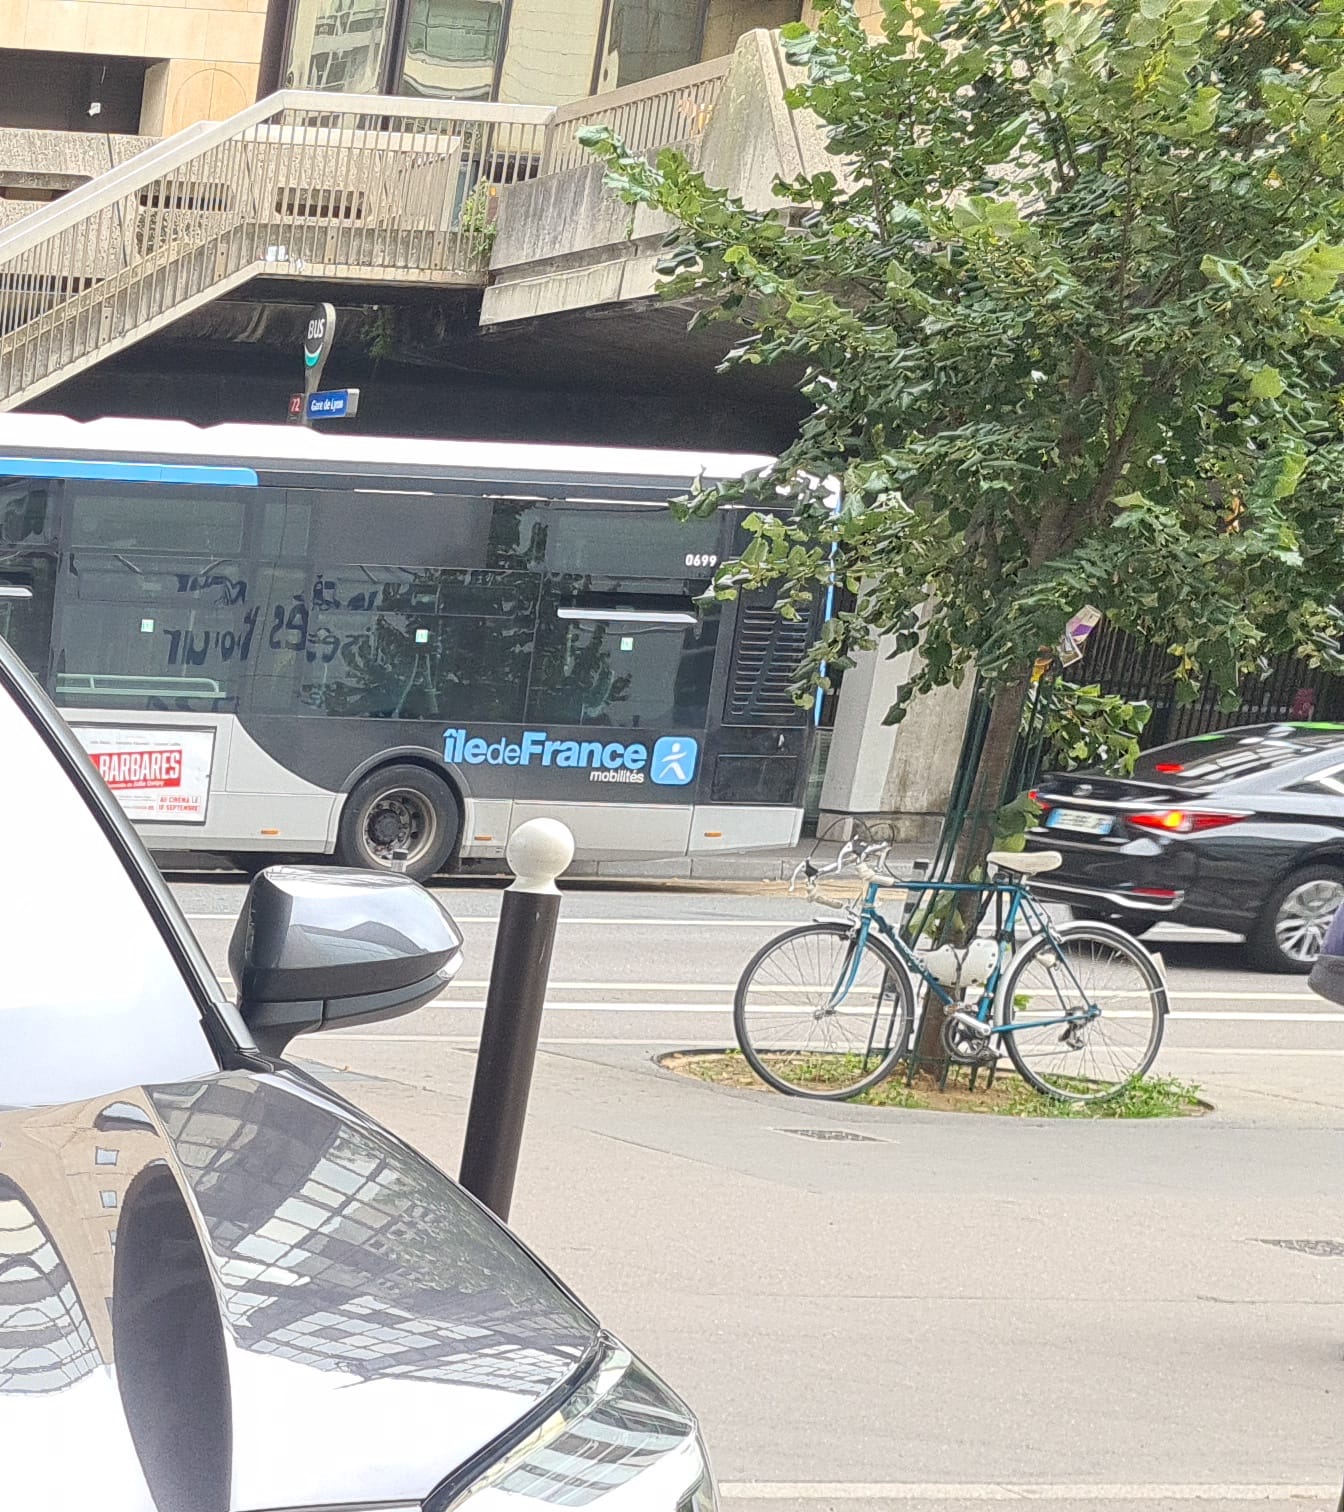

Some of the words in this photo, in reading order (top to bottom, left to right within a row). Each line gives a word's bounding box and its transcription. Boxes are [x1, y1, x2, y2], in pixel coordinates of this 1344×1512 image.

[307, 318, 325, 340] BUS
[291, 398, 301, 412] 72
[685, 553, 718, 567] 0699
[99, 751, 181, 782] BARBARES
[589, 769, 645, 784] mobilités
